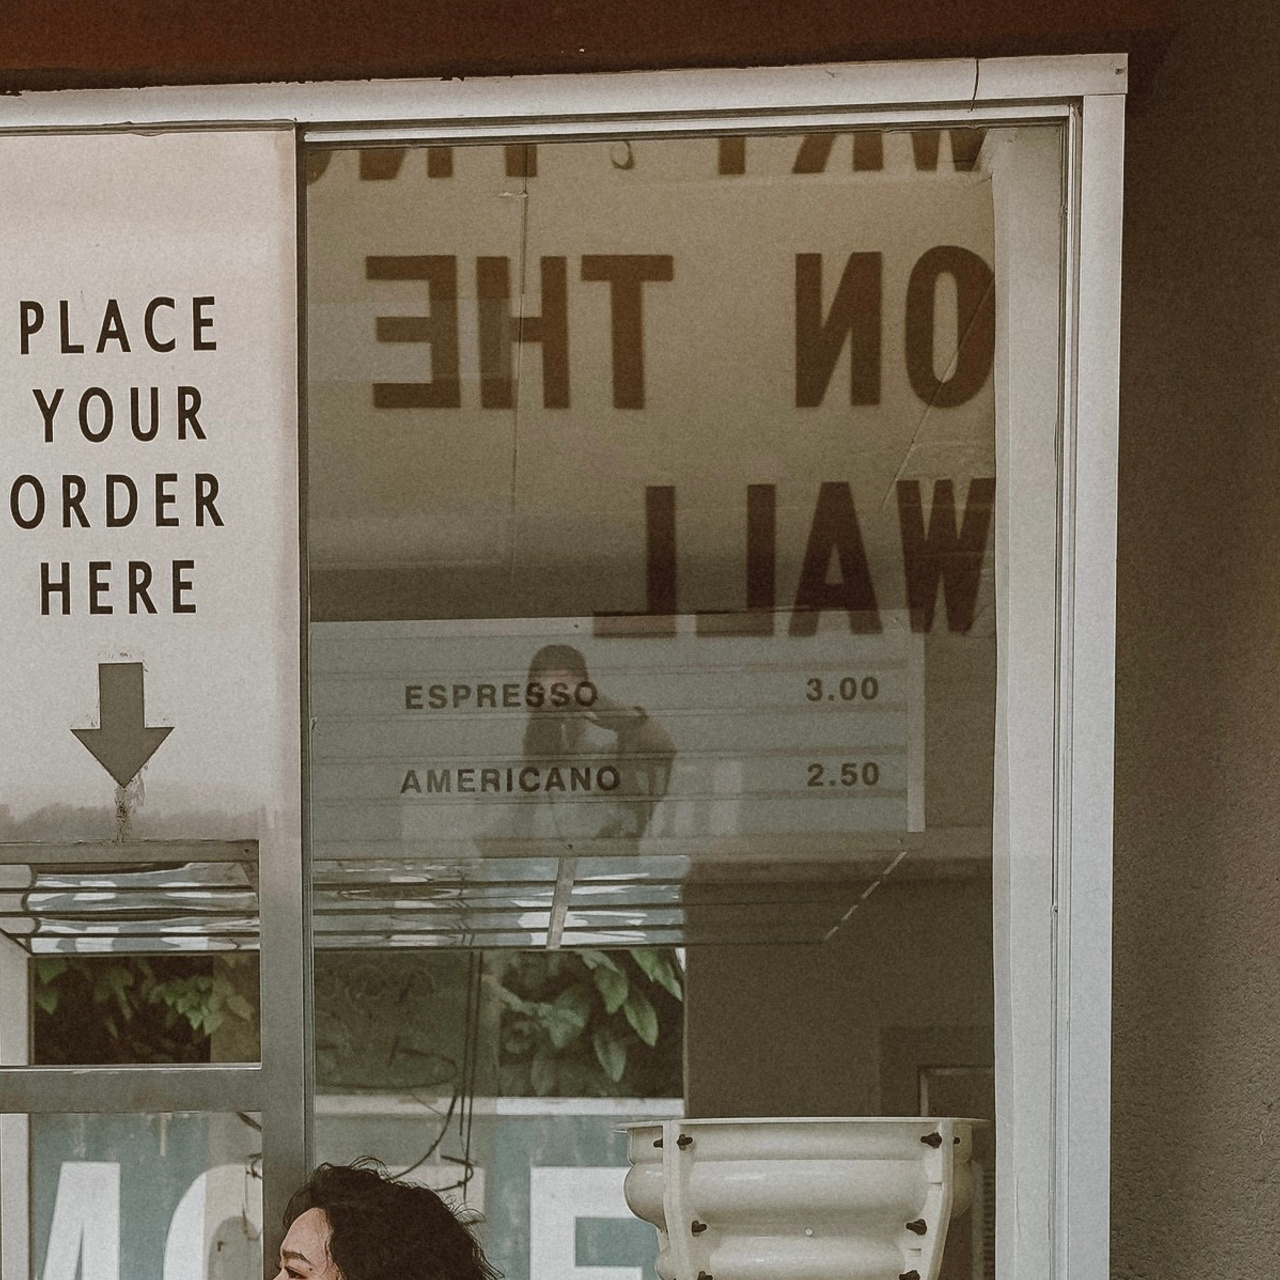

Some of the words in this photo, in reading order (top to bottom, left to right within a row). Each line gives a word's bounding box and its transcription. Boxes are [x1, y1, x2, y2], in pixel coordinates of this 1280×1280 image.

[20, 296, 218, 355] PLACE
[32, 385, 207, 444] YOUR
[9, 472, 225, 530] ORDER
[39, 559, 197, 616] HERE
[405, 681, 599, 710] ESPRESSO
[806, 676, 879, 702] 3.00
[400, 764, 621, 794] AMERICANO
[807, 762, 880, 787] 2.50
